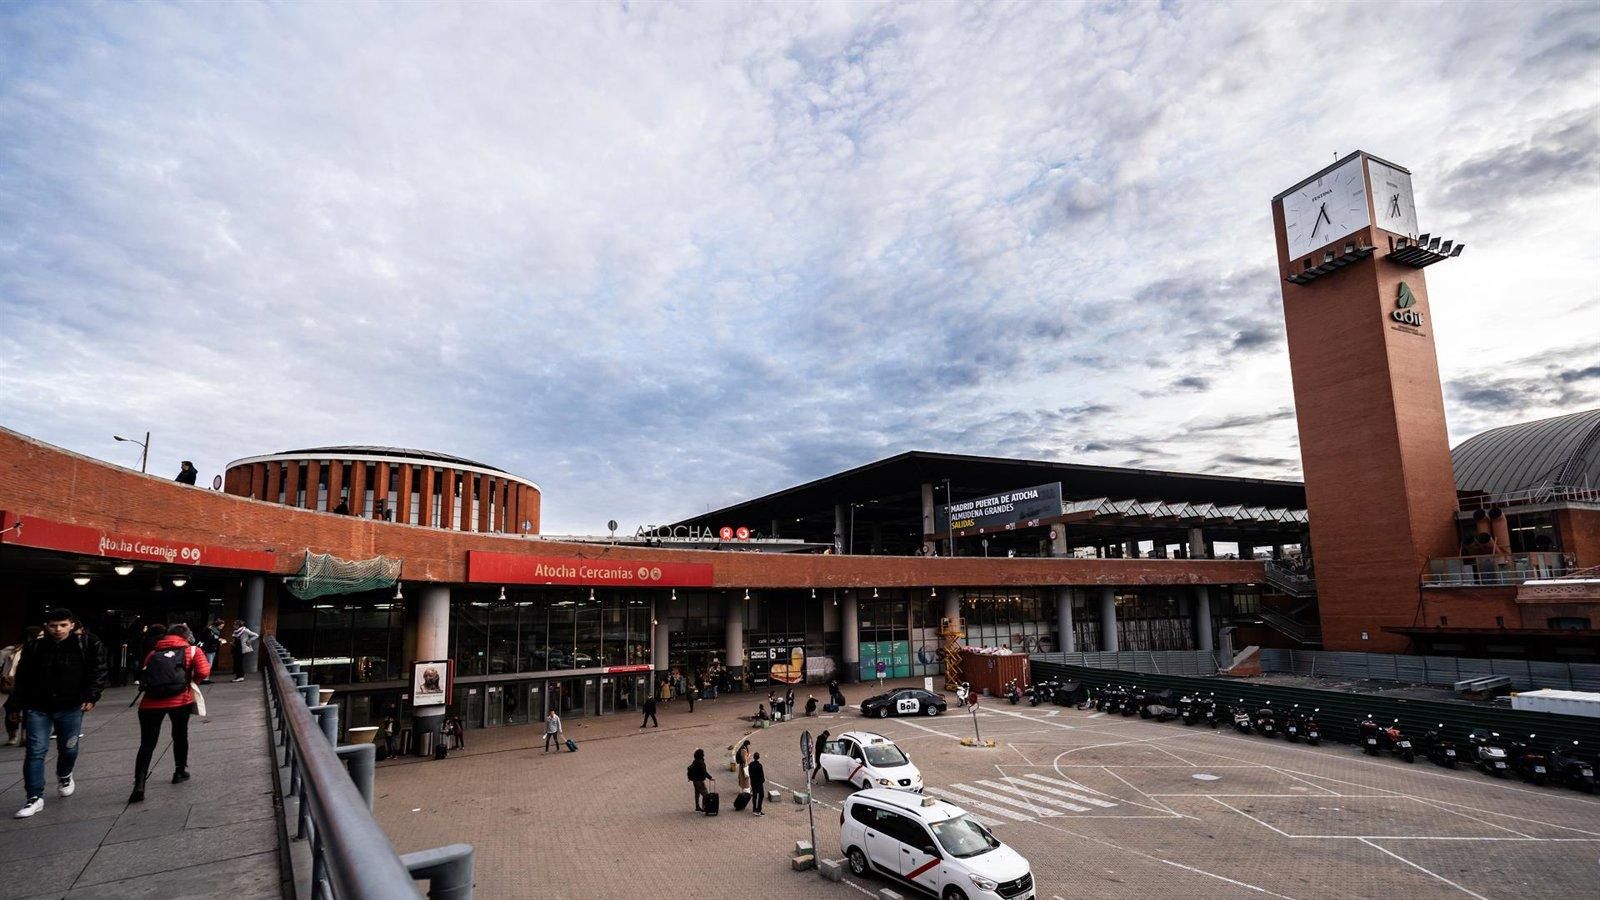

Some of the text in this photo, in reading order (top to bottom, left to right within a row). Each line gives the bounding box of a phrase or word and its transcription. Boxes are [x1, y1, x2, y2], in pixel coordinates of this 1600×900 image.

[950, 490, 1038, 513] MADRID PUERTA DE ATOCHA
[951, 503, 1014, 520] ALMUDENA GRANDES
[951, 519, 975, 529] SALIDAS
[634, 524, 714, 541] ATOCHA
[535, 563, 633, 579] Atocha Cercanías
[769, 647, 777, 659] 6
[901, 701, 917, 712] Bolt
